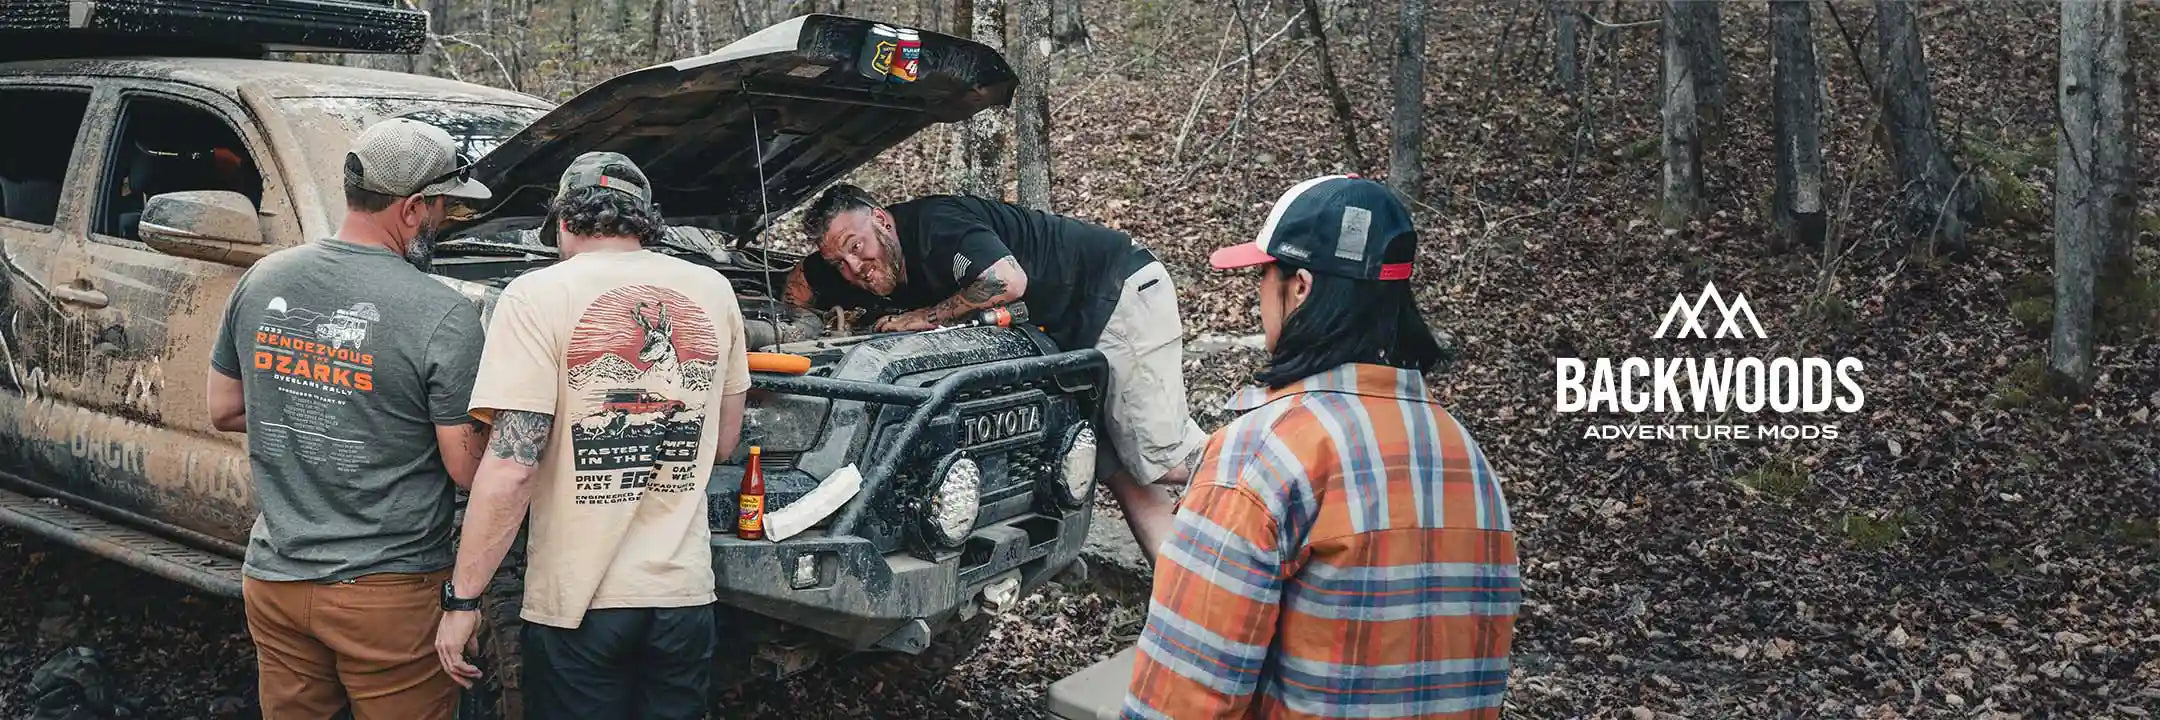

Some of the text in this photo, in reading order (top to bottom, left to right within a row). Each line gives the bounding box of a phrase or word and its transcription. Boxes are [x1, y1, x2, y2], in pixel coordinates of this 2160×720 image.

[256, 331, 374, 366] RENDEZVOUS
[255, 351, 373, 391] OZARKS
[322, 385, 353, 396] RALLY
[964, 406, 1041, 445] TOYOTA
[578, 445, 649, 456] FASTEST
[580, 457, 603, 465] IN
[612, 454, 652, 463] THE
[575, 474, 612, 482] DRIVE
[575, 491, 634, 500] ENGINEERED
